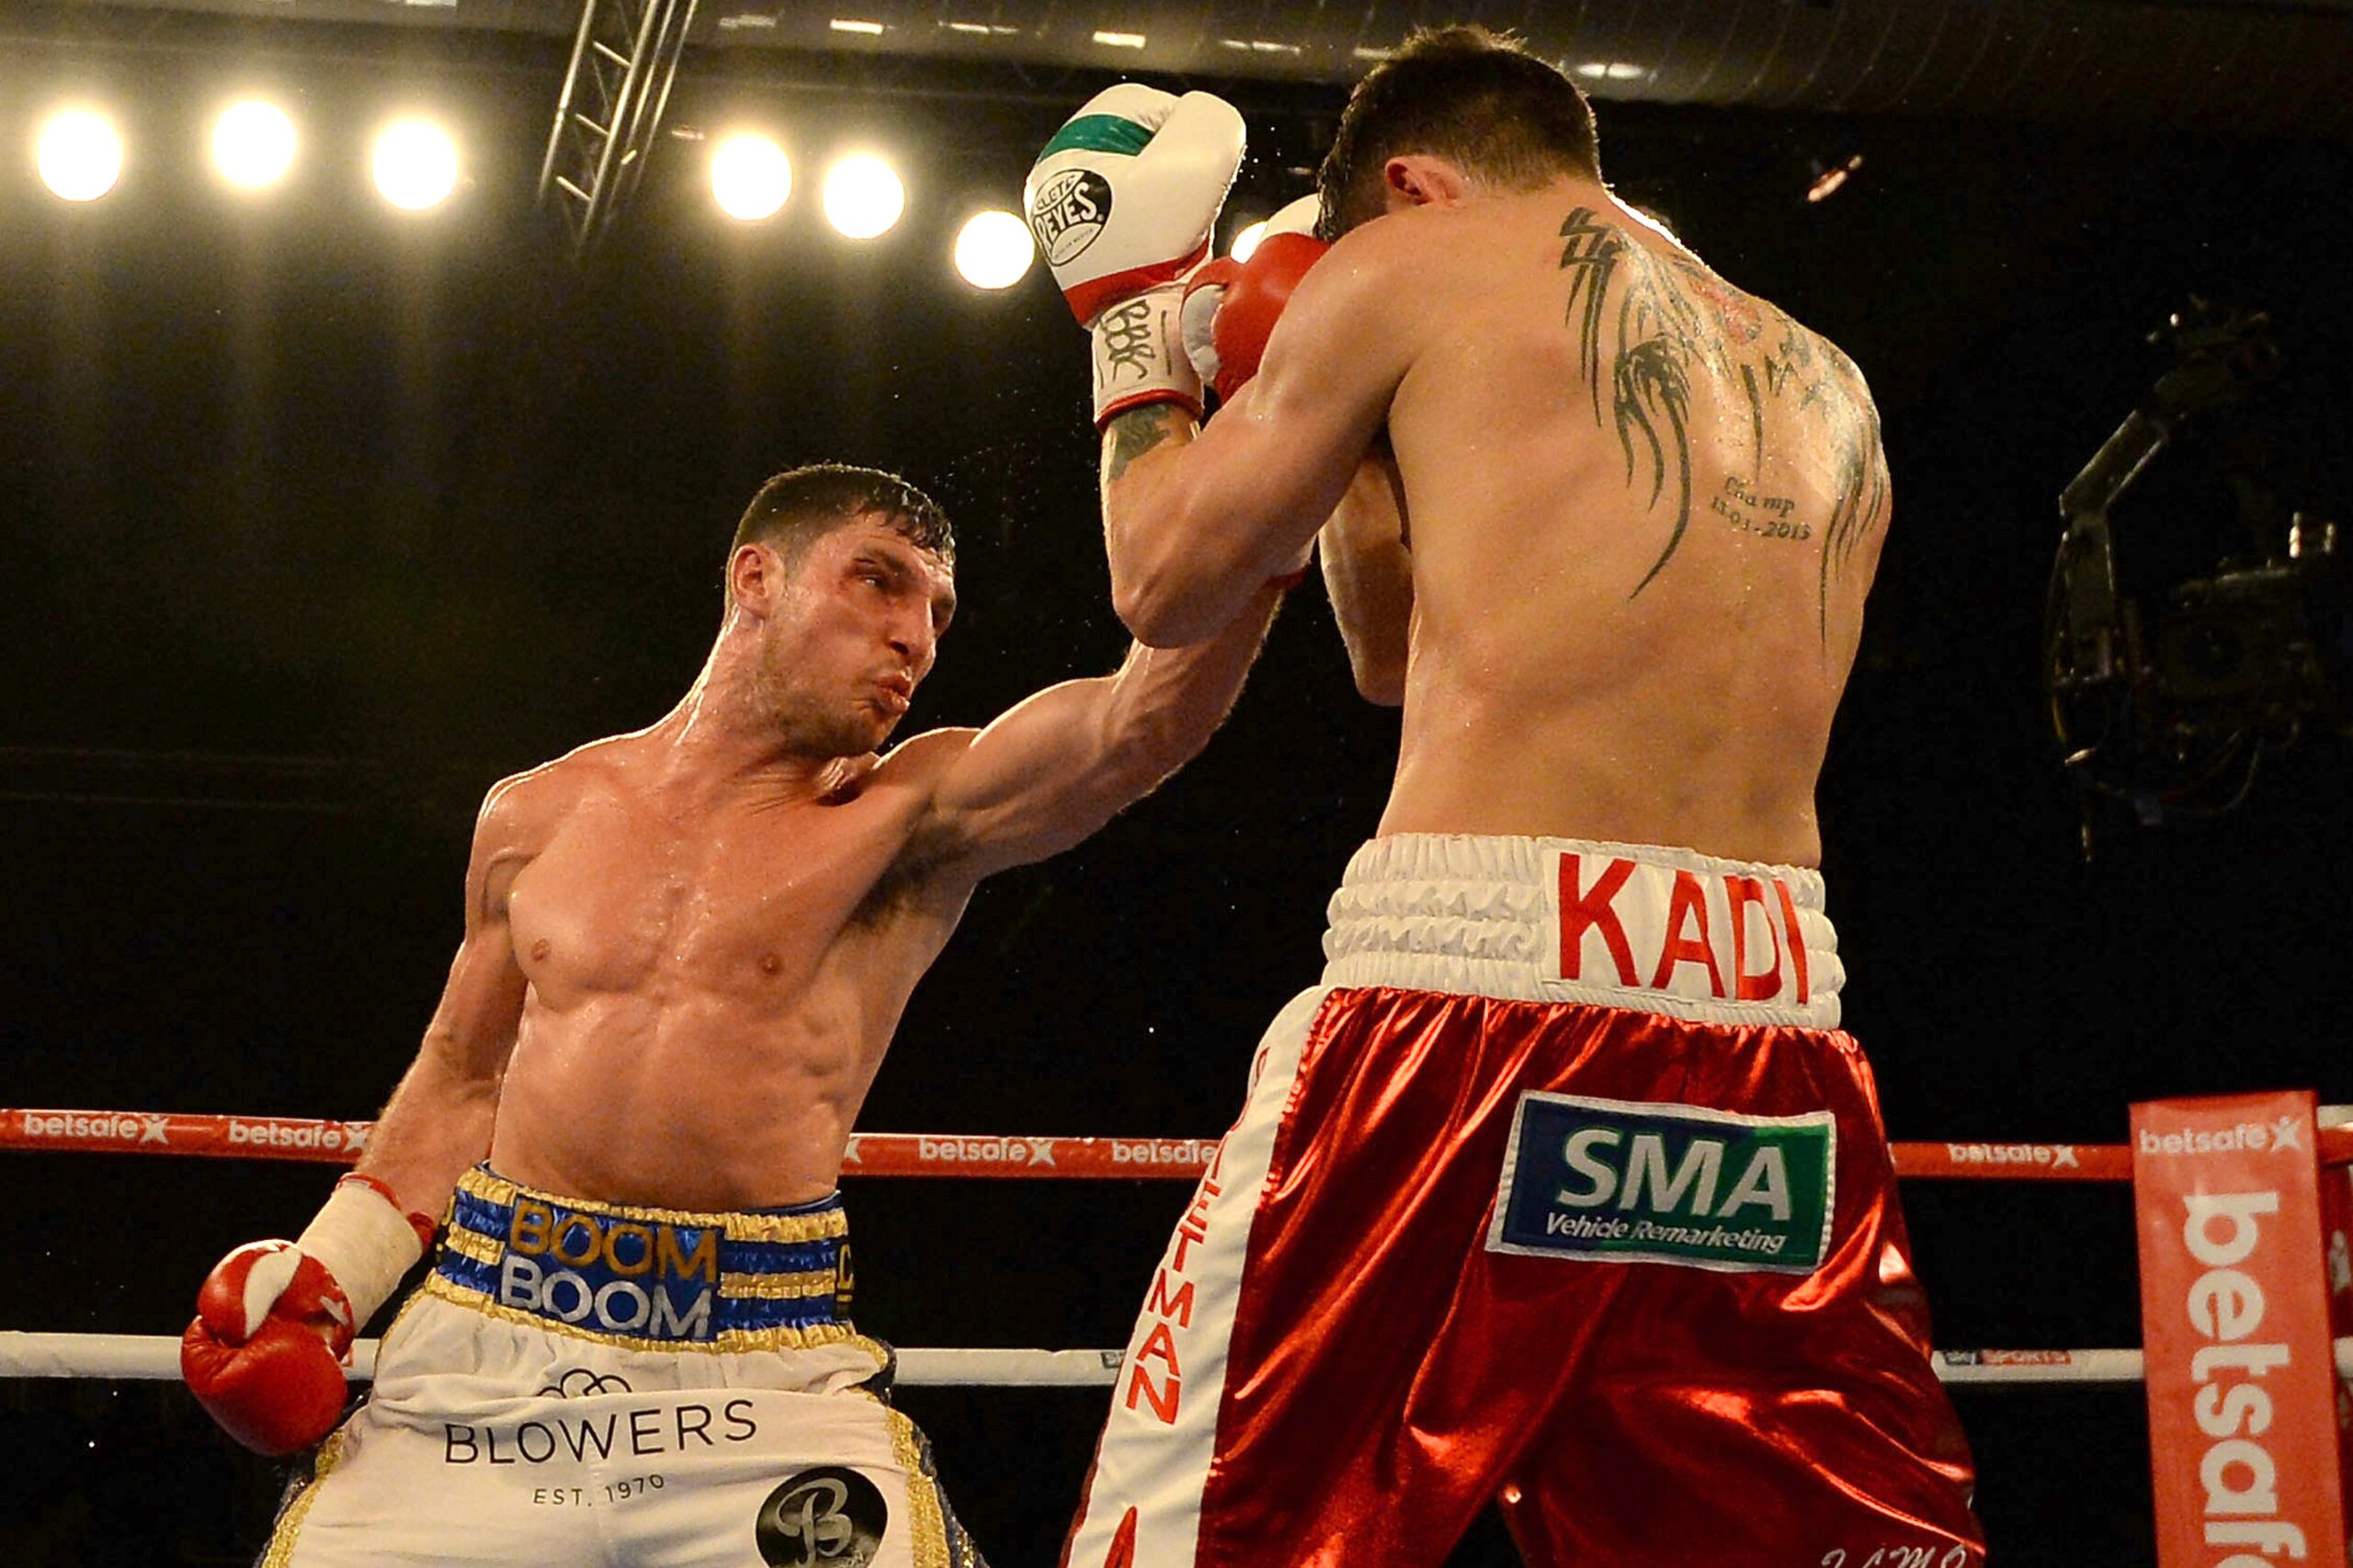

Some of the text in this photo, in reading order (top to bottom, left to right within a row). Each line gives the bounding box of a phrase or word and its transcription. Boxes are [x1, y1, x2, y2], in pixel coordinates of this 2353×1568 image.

[1034, 181, 1098, 255] REYES
[1724, 476, 1795, 517] Champ
[1557, 852, 1809, 1005] KADI
[23, 1112, 140, 1139] betsafe
[227, 1119, 343, 1148] betsafe
[2140, 1123, 2268, 1155] betsafe
[918, 1138, 1028, 1163] betsafe
[1112, 1140, 1216, 1164] betsafe
[1949, 1143, 2052, 1164] betsafe
[1556, 1129, 1791, 1221] SMA
[509, 1200, 717, 1283] BOOM
[1546, 1211, 1788, 1255] Vehicle Remarketing
[501, 1256, 712, 1337] BOOM
[2182, 1191, 2307, 1568] betsaf
[445, 1399, 757, 1464] BLOWERS
[533, 1473, 665, 1507] EST. 1970
